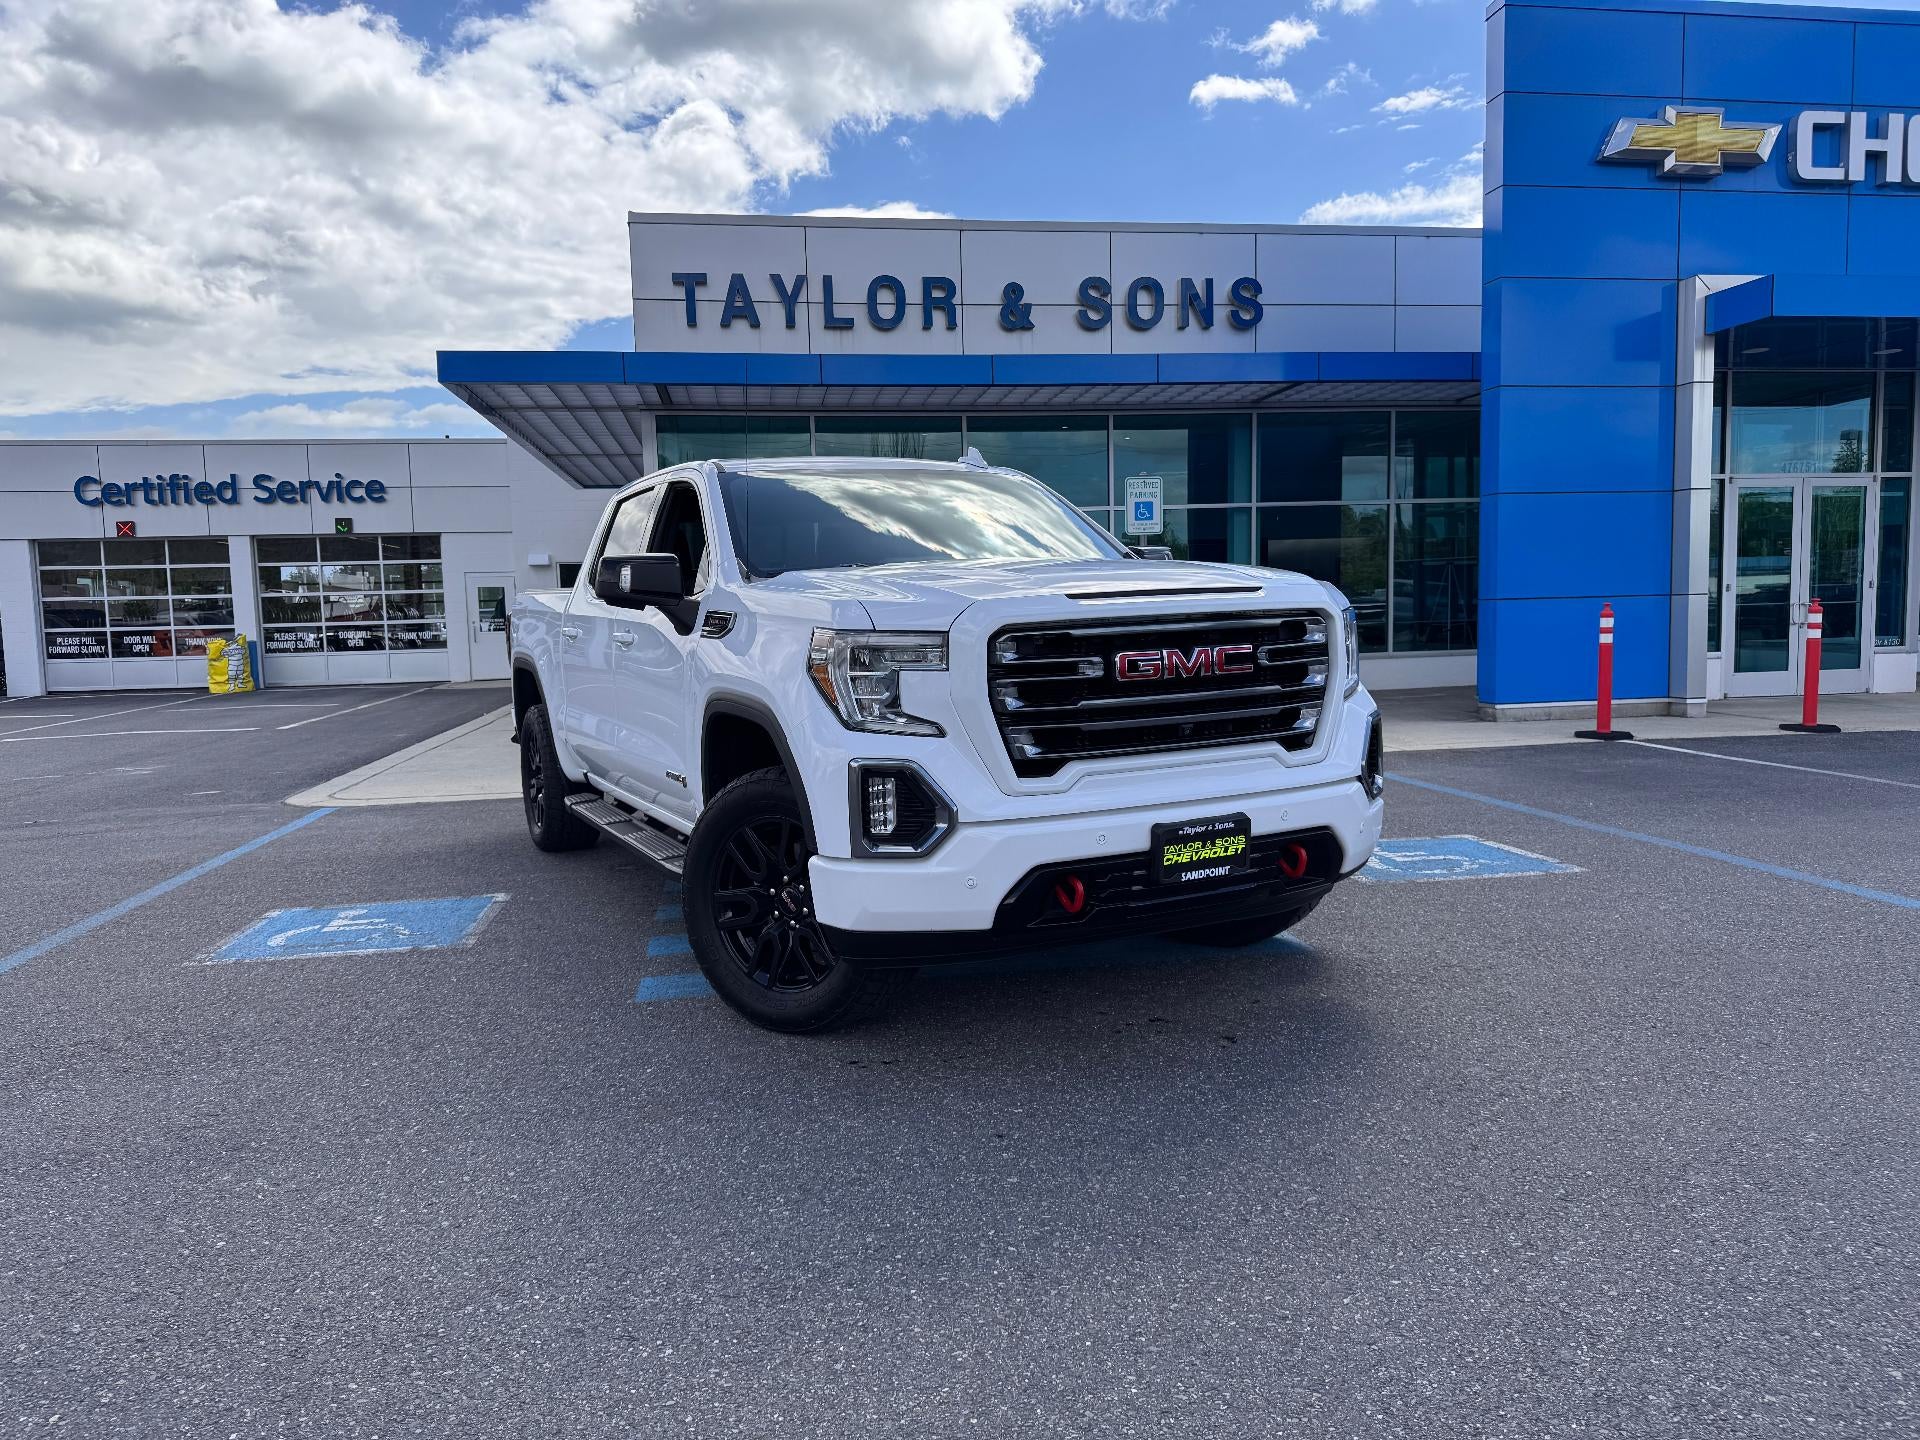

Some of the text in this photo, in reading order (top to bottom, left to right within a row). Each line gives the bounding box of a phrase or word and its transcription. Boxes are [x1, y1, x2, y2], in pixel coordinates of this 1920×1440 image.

[671, 271, 1264, 331] TAYLOR & SONS
[73, 472, 386, 506] Certified Service
[1128, 481, 1159, 490] RESERVED
[1130, 491, 1158, 499] PARKING
[123, 635, 157, 644] DOOR WILL
[274, 633, 296, 641] PLEASE
[339, 631, 354, 639] DOOR
[399, 631, 433, 640] THANK YOU!
[56, 637, 97, 646] PLEASE PULL
[185, 638, 206, 646] THANK
[267, 640, 320, 649] FORWARD SLOWLY
[48, 645, 106, 654] FORWARD SLOWLY
[132, 644, 149, 652] OPEN
[1115, 644, 1254, 682] GMC
[1163, 841, 1203, 854] TAYLOR
[1215, 835, 1246, 847] SONS
[1163, 845, 1246, 866] CHEVROLET
[1181, 866, 1231, 881] SANDPOINT
